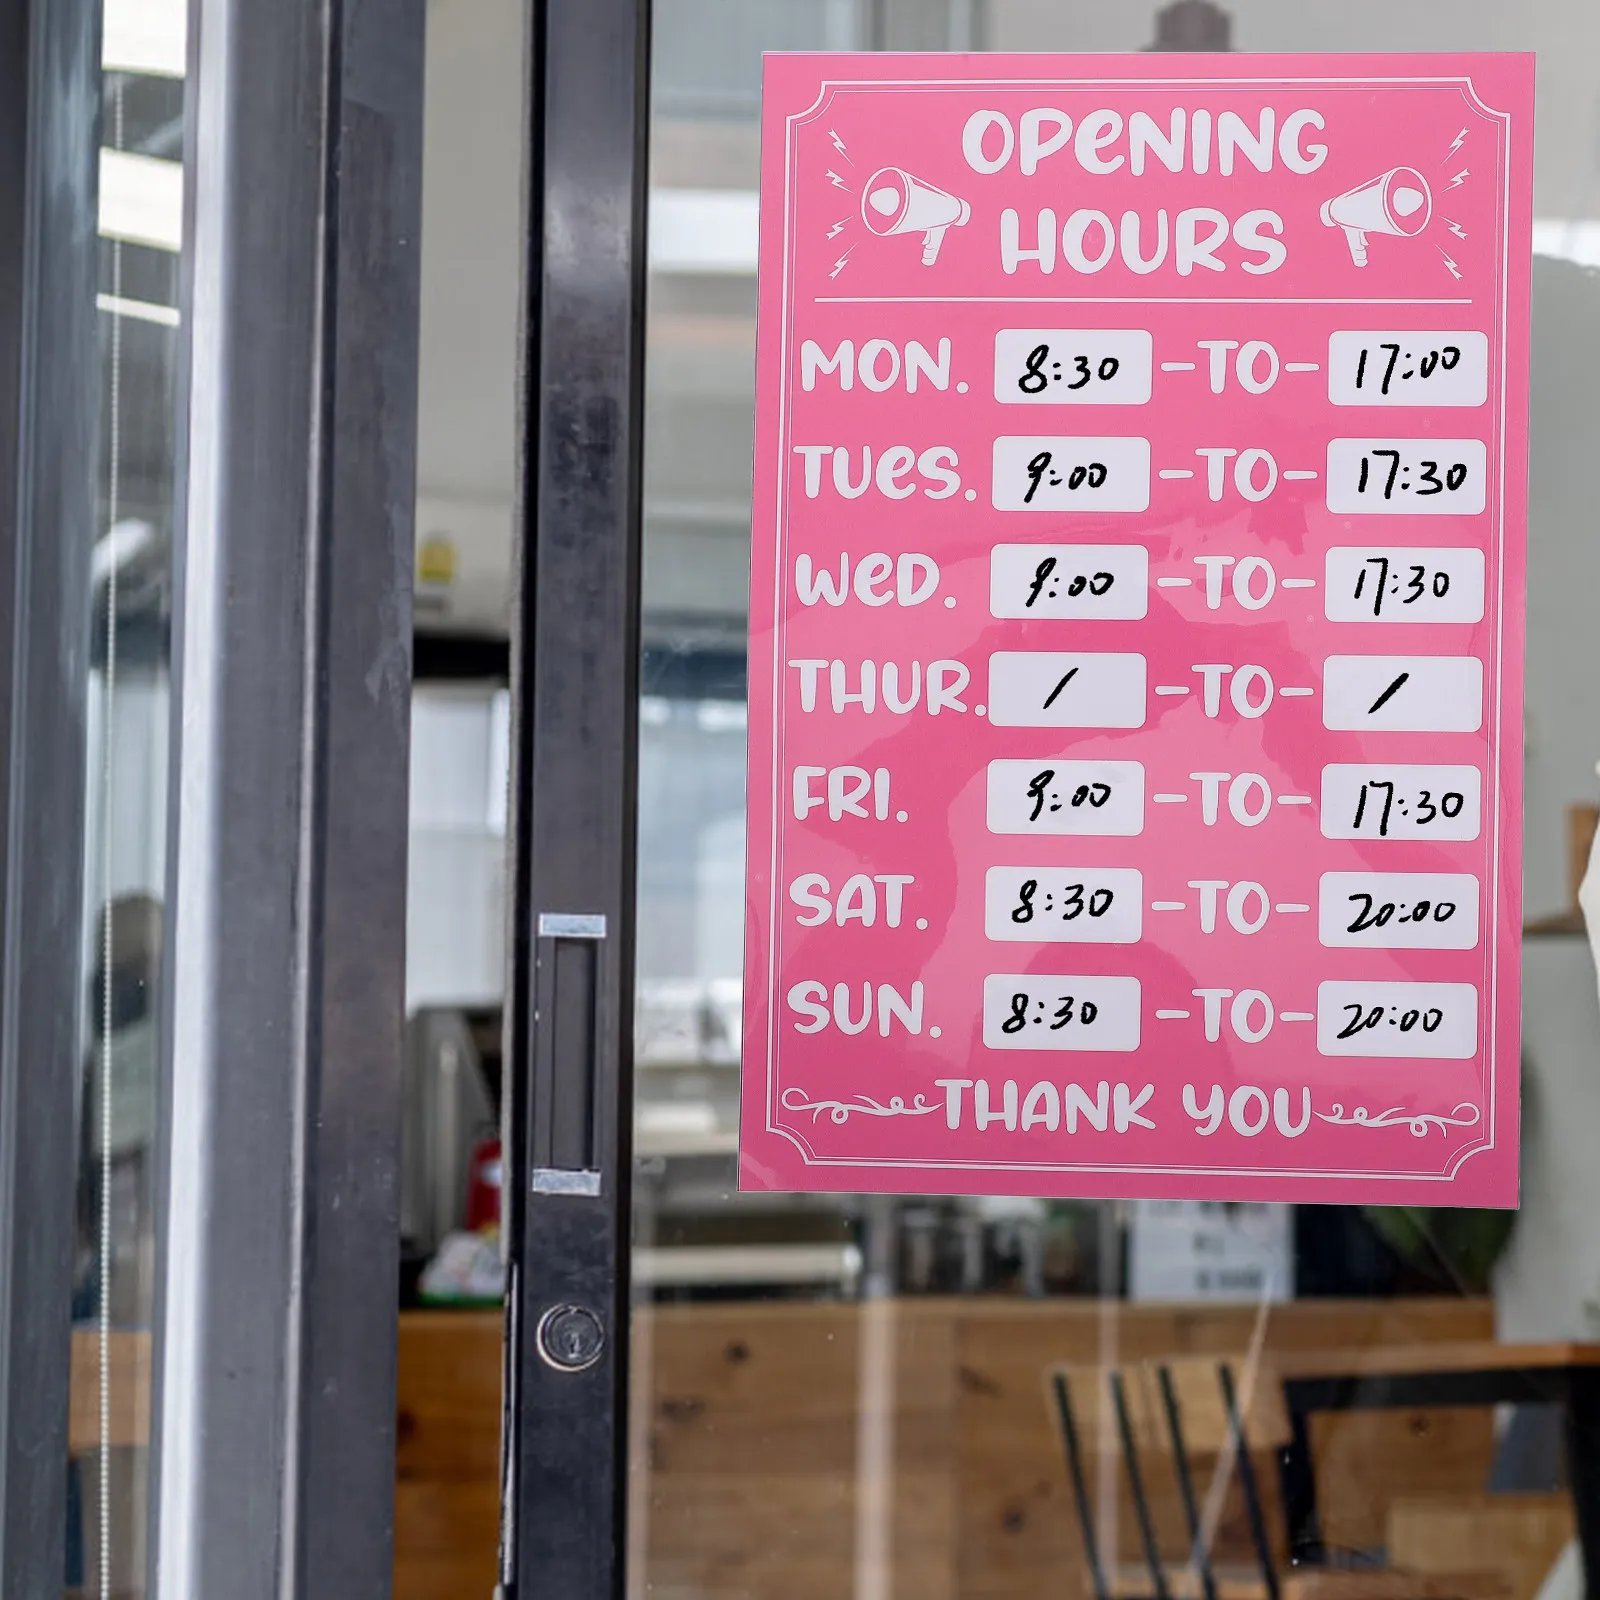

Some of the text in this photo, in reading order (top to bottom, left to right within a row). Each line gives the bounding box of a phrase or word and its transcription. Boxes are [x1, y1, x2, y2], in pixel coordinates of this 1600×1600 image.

[1000, 207, 1288, 277] HOURS
[800, 337, 969, 394] MON.
[1018, 344, 1121, 394] 8:30
[1356, 343, 1461, 395] 17:00
[1023, 451, 1108, 504] 9:00
[1357, 449, 1468, 500] 17:30
[1025, 556, 1115, 608] 9:00
[1353, 557, 1450, 617] 17:30
[787, 659, 987, 717] THUR.
[792, 765, 909, 823] FRI.
[1026, 769, 1112, 822] 9:00
[1352, 780, 1464, 837] 17:30
[789, 873, 928, 931] SAT.
[1011, 879, 1114, 924] 8:30
[1346, 893, 1457, 933] 20:00
[787, 980, 942, 1039] SUN.
[1001, 992, 1098, 1034] 8:30
[1336, 1003, 1443, 1040] 20:00
[934, 1079, 1311, 1138] THANK YOU
